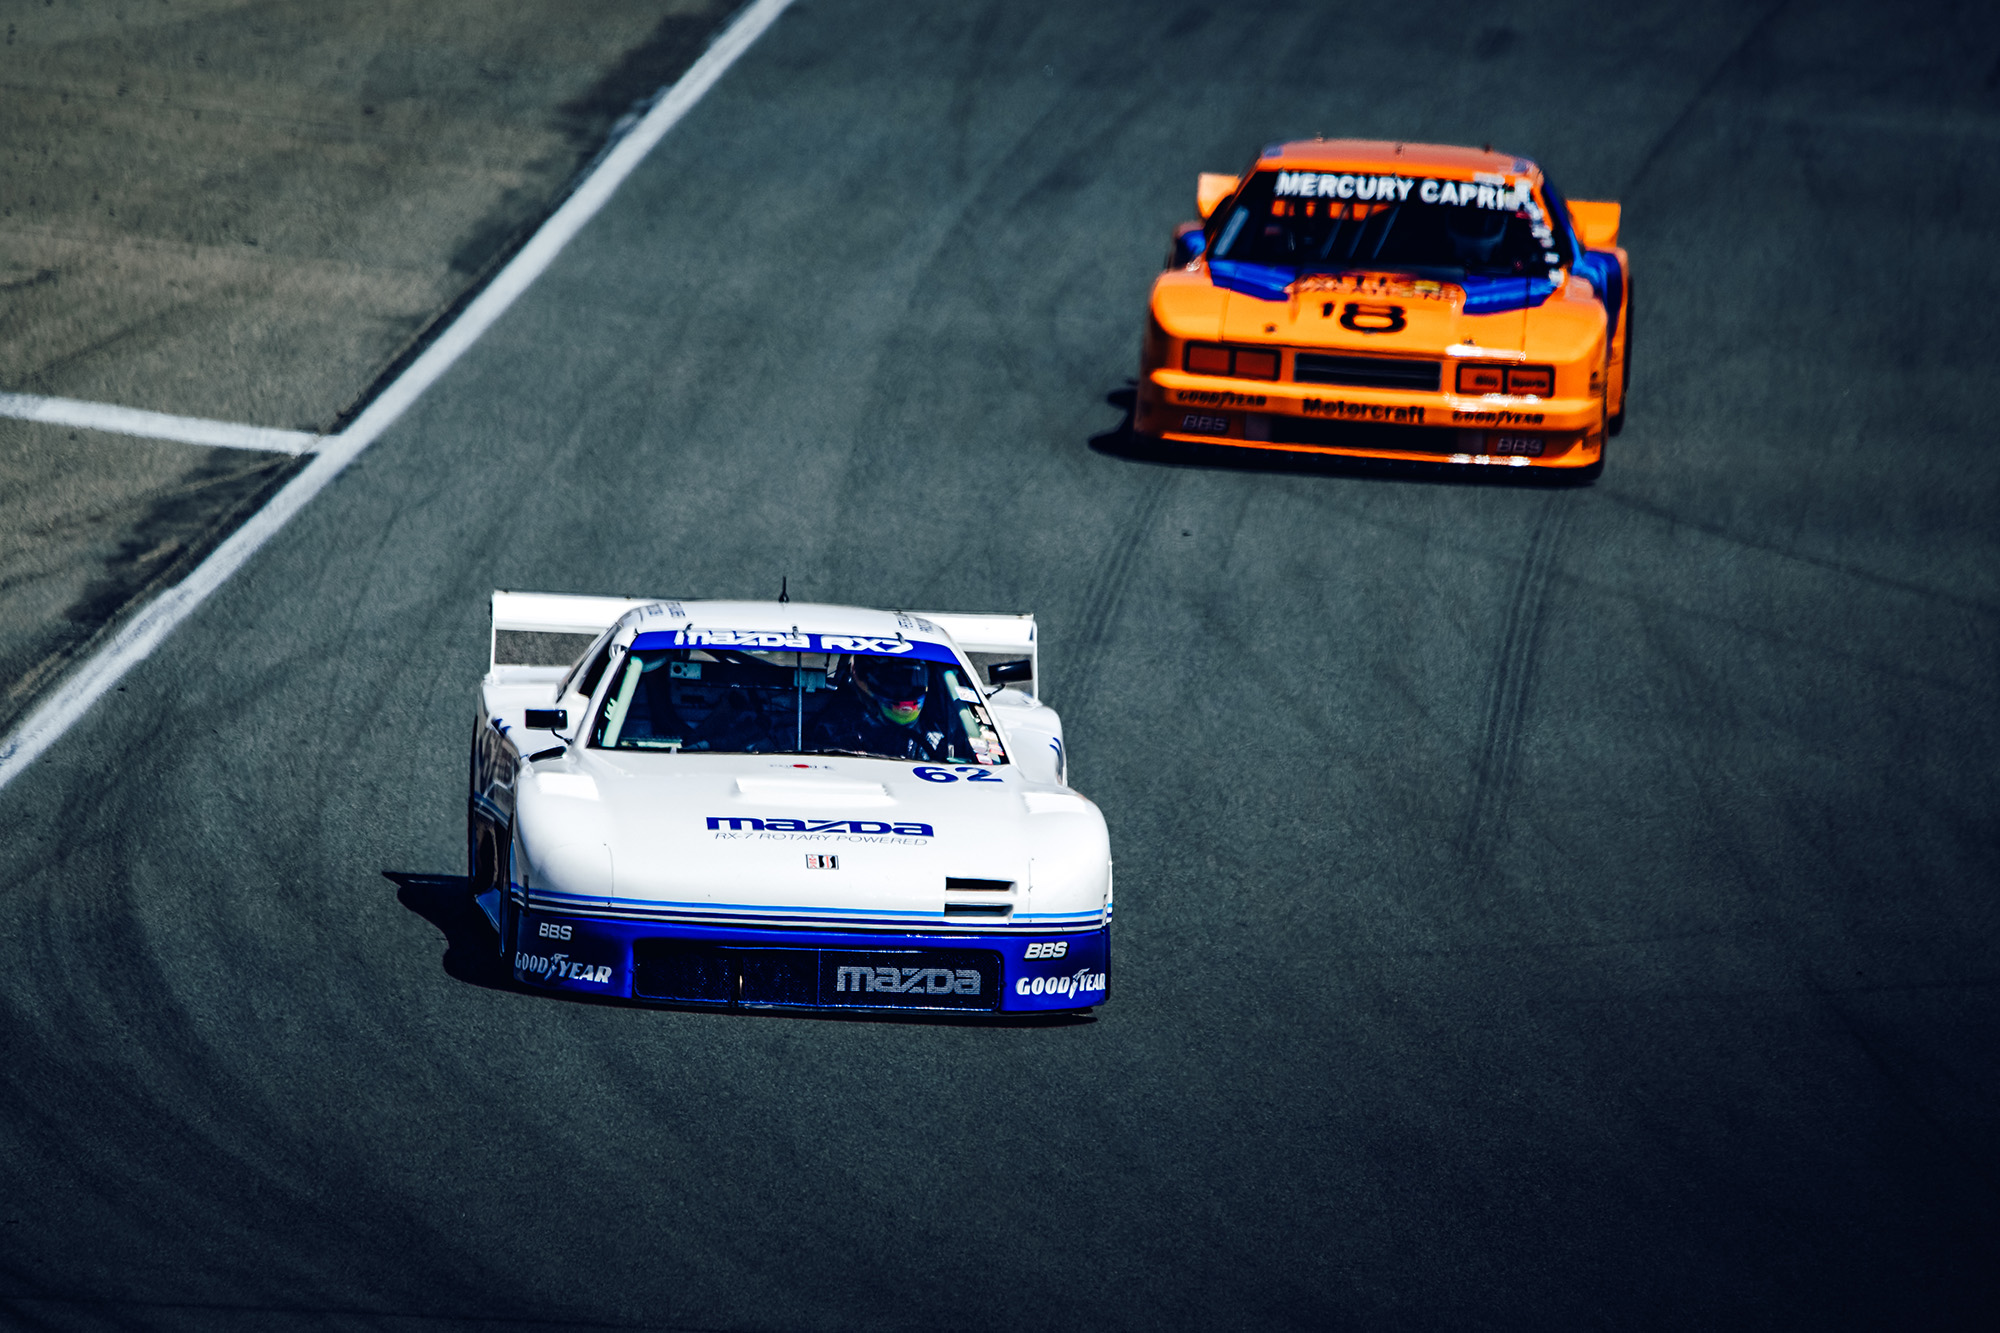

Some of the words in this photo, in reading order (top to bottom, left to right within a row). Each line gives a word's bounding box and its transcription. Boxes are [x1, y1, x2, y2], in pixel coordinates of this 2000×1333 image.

[1274, 171, 1415, 201] MERCURY
[1420, 178, 1507, 211] CAPRI
[1303, 398, 1425, 424] Motorcraft
[912, 766, 1004, 783] 62
[714, 832, 754, 840] RX-7
[759, 833, 831, 843] ROTARY
[836, 835, 928, 846] POWERED
[539, 922, 573, 941] BBS
[1024, 941, 1068, 959] BBS
